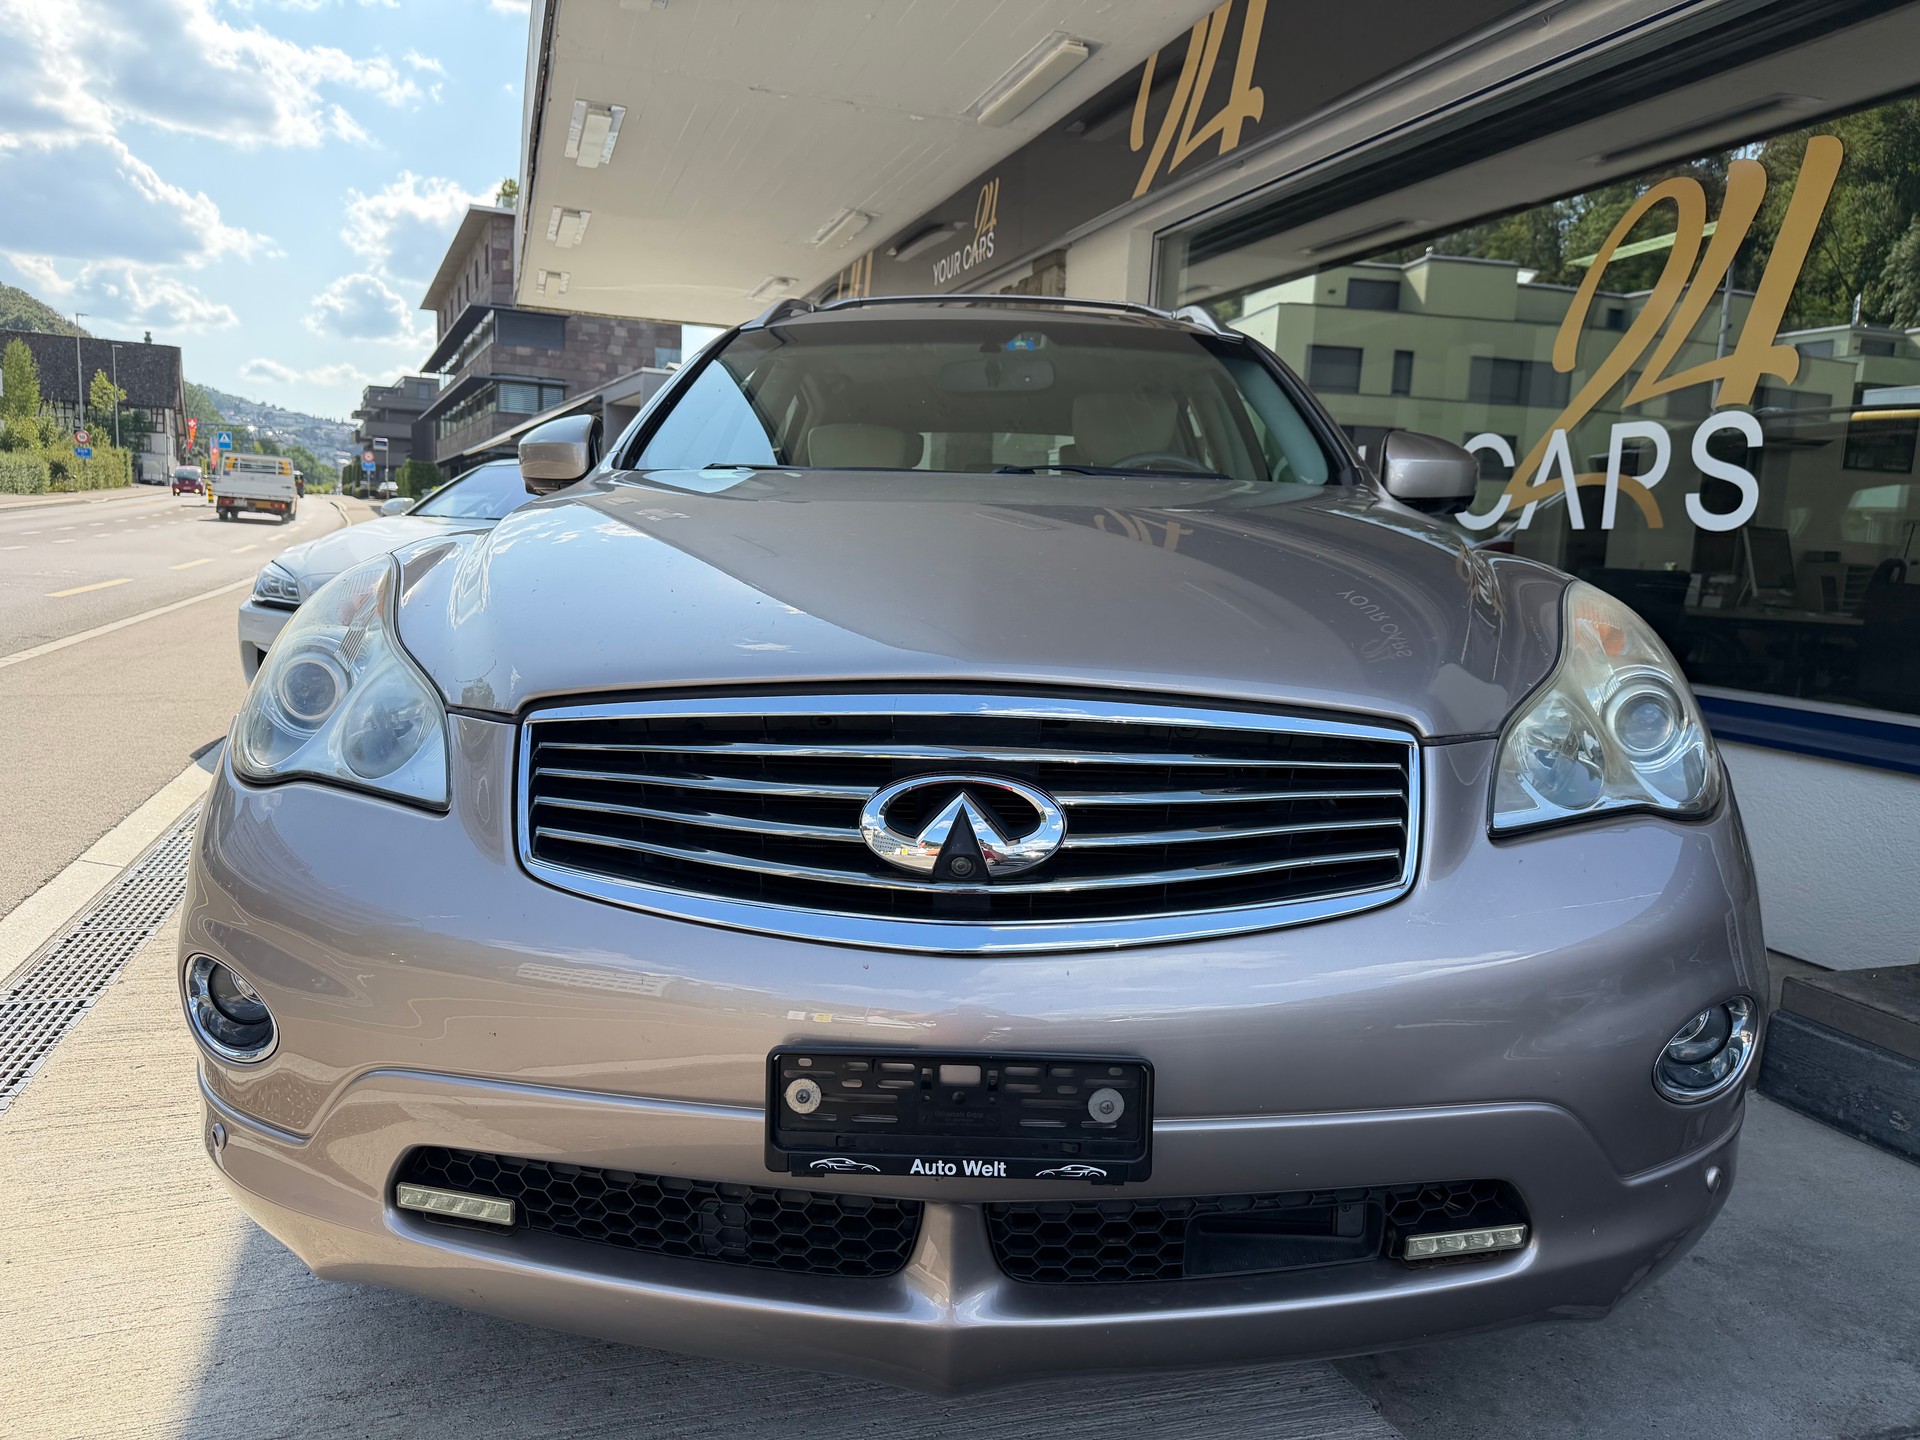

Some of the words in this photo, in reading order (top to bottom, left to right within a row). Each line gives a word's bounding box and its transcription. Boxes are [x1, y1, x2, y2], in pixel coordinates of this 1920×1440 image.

[932, 250, 961, 286] YOUR
[962, 231, 995, 271] CARS
[1504, 135, 1843, 529] 24
[1455, 410, 1763, 531] CARS
[909, 1158, 957, 1176] Auto
[962, 1159, 1007, 1177] Welt
